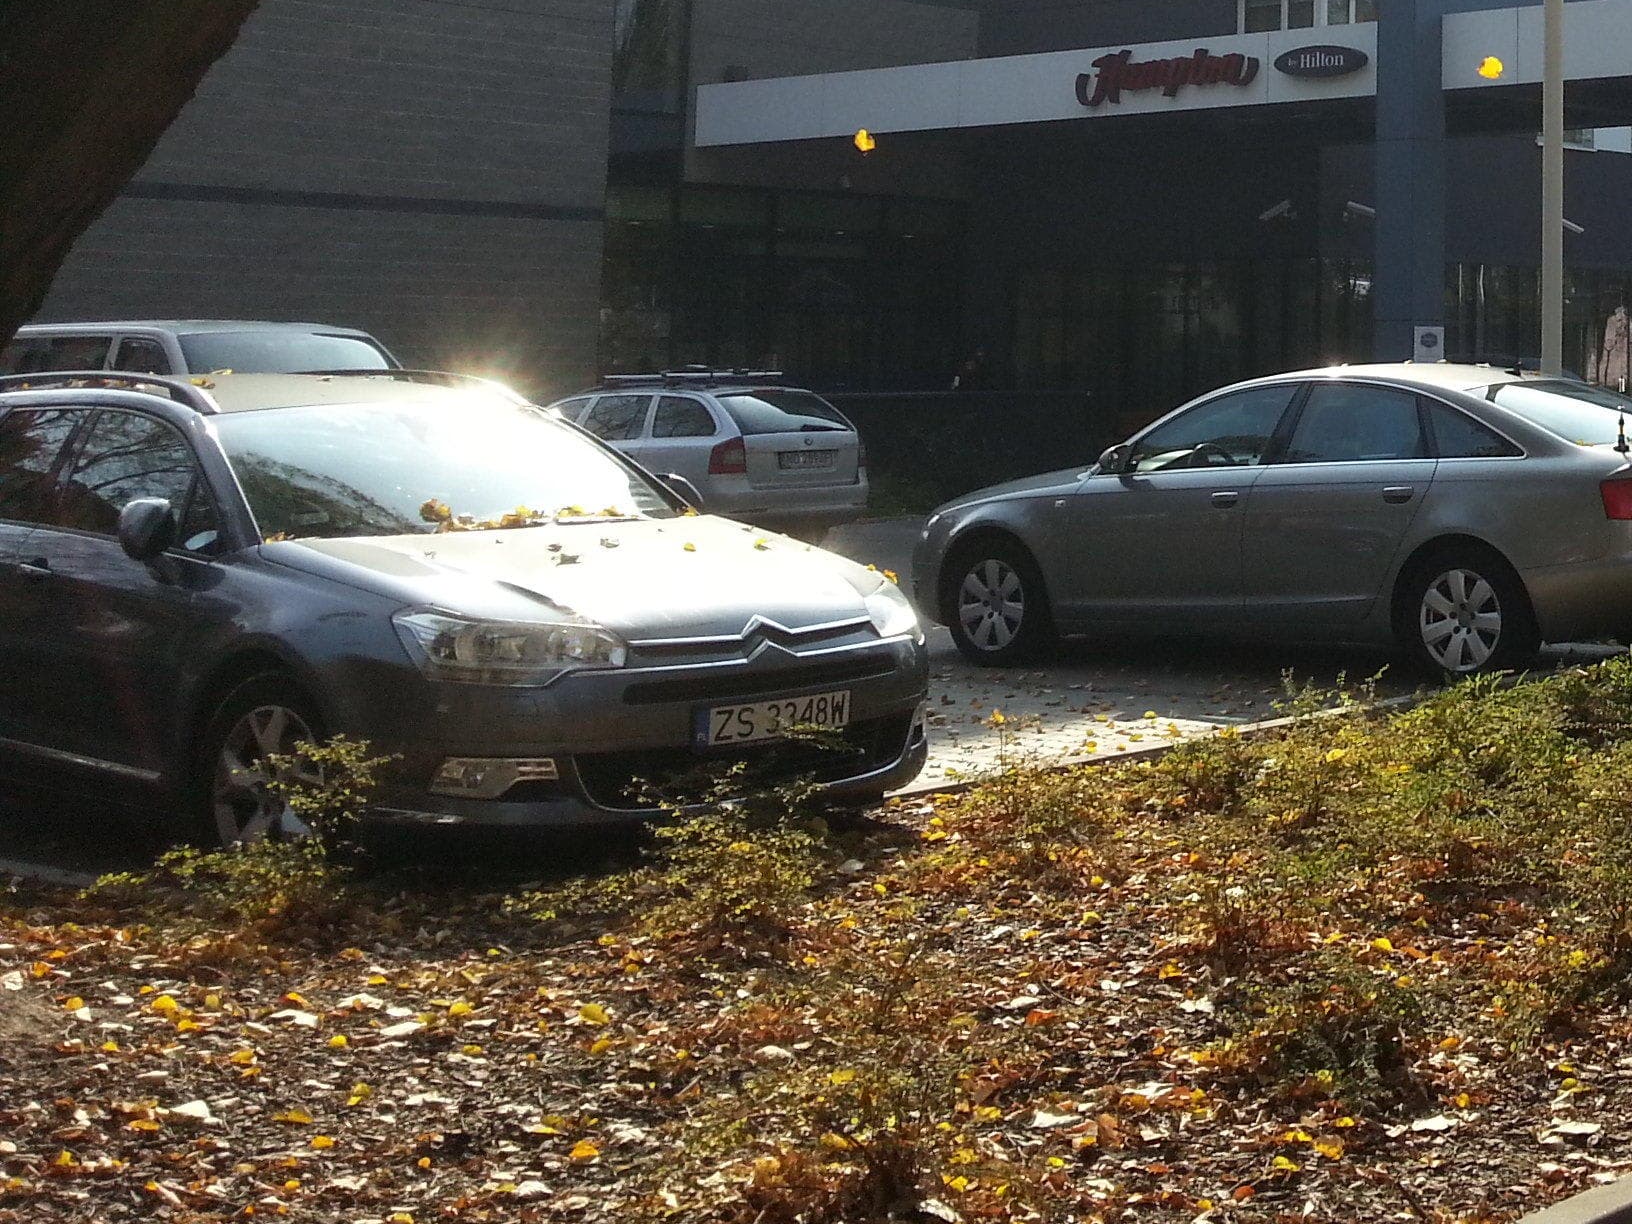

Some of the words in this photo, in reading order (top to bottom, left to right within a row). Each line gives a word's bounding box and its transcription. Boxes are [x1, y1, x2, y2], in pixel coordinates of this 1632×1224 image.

[1300, 51, 1344, 69] Hilton
[714, 707, 755, 742] ZS
[765, 693, 846, 734] 3348W
